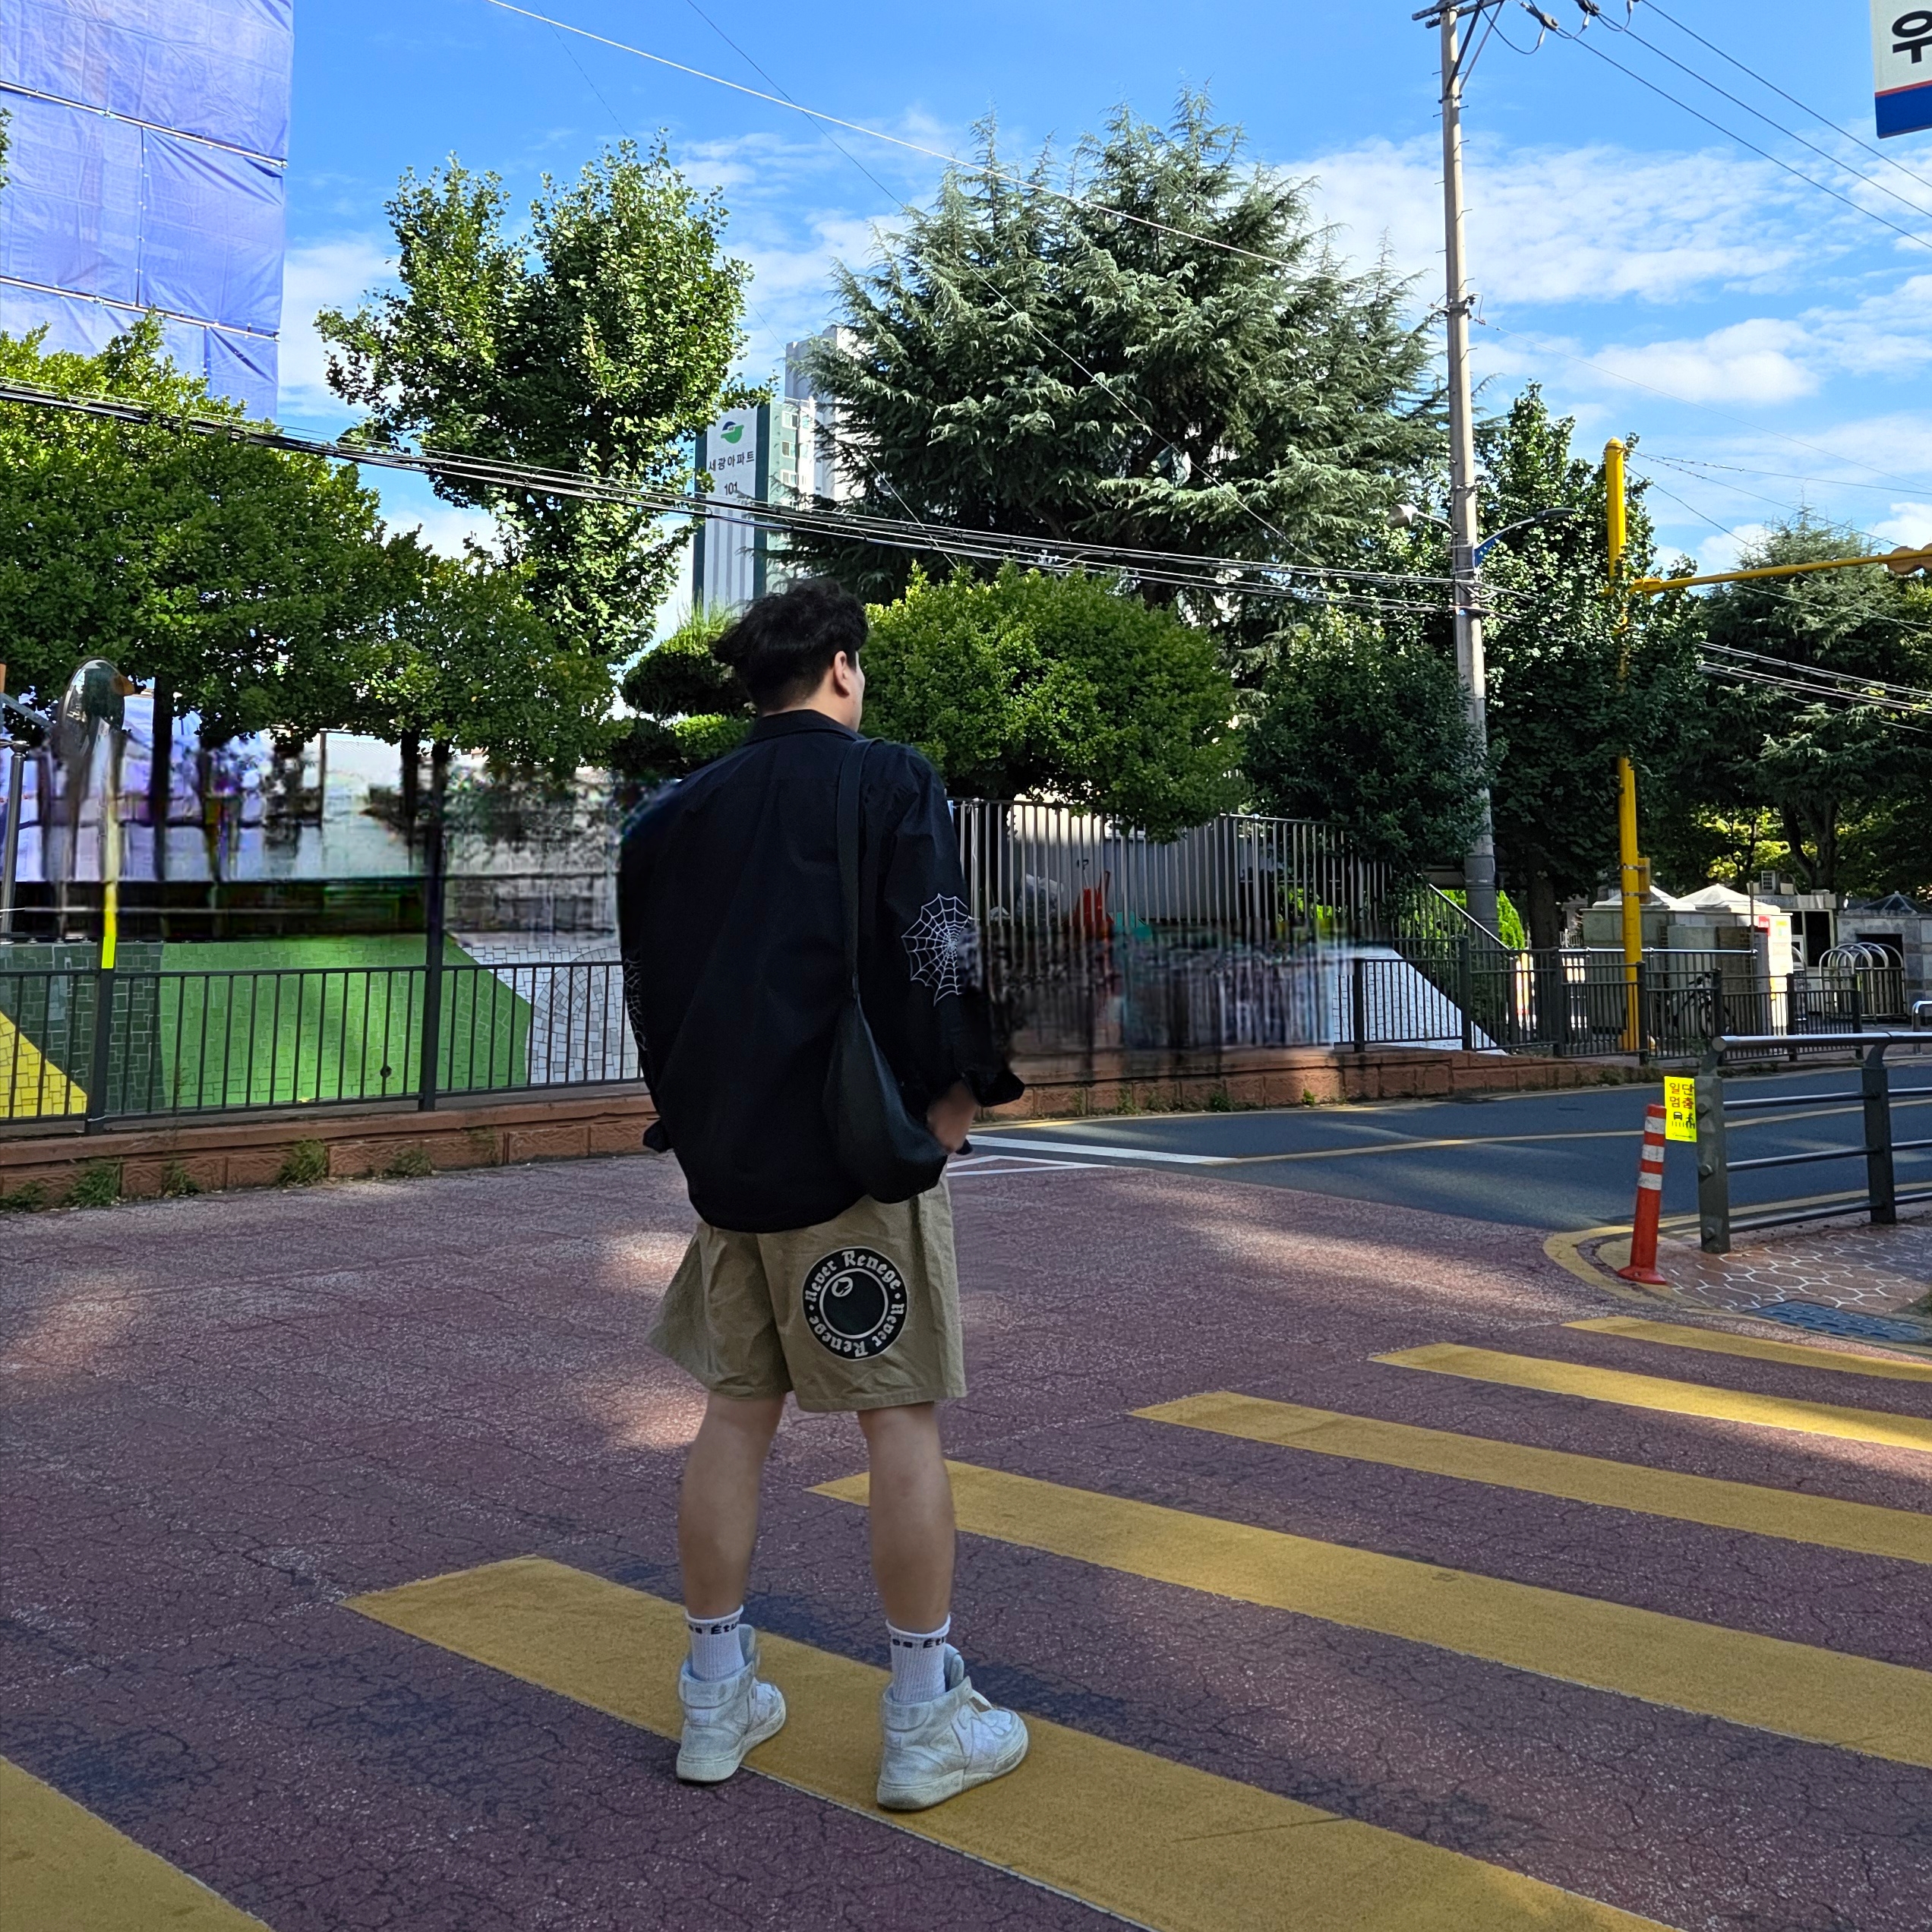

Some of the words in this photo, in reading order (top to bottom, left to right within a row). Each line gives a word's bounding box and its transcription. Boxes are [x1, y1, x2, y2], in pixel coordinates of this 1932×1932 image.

[709, 451, 754, 472] 세광아파트
[724, 481, 738, 496] 101
[1669, 1083, 1694, 1096] 일단
[1669, 1097, 1694, 1110] 멈춤
[805, 1260, 837, 1302] Never
[841, 1250, 901, 1290] Renege
